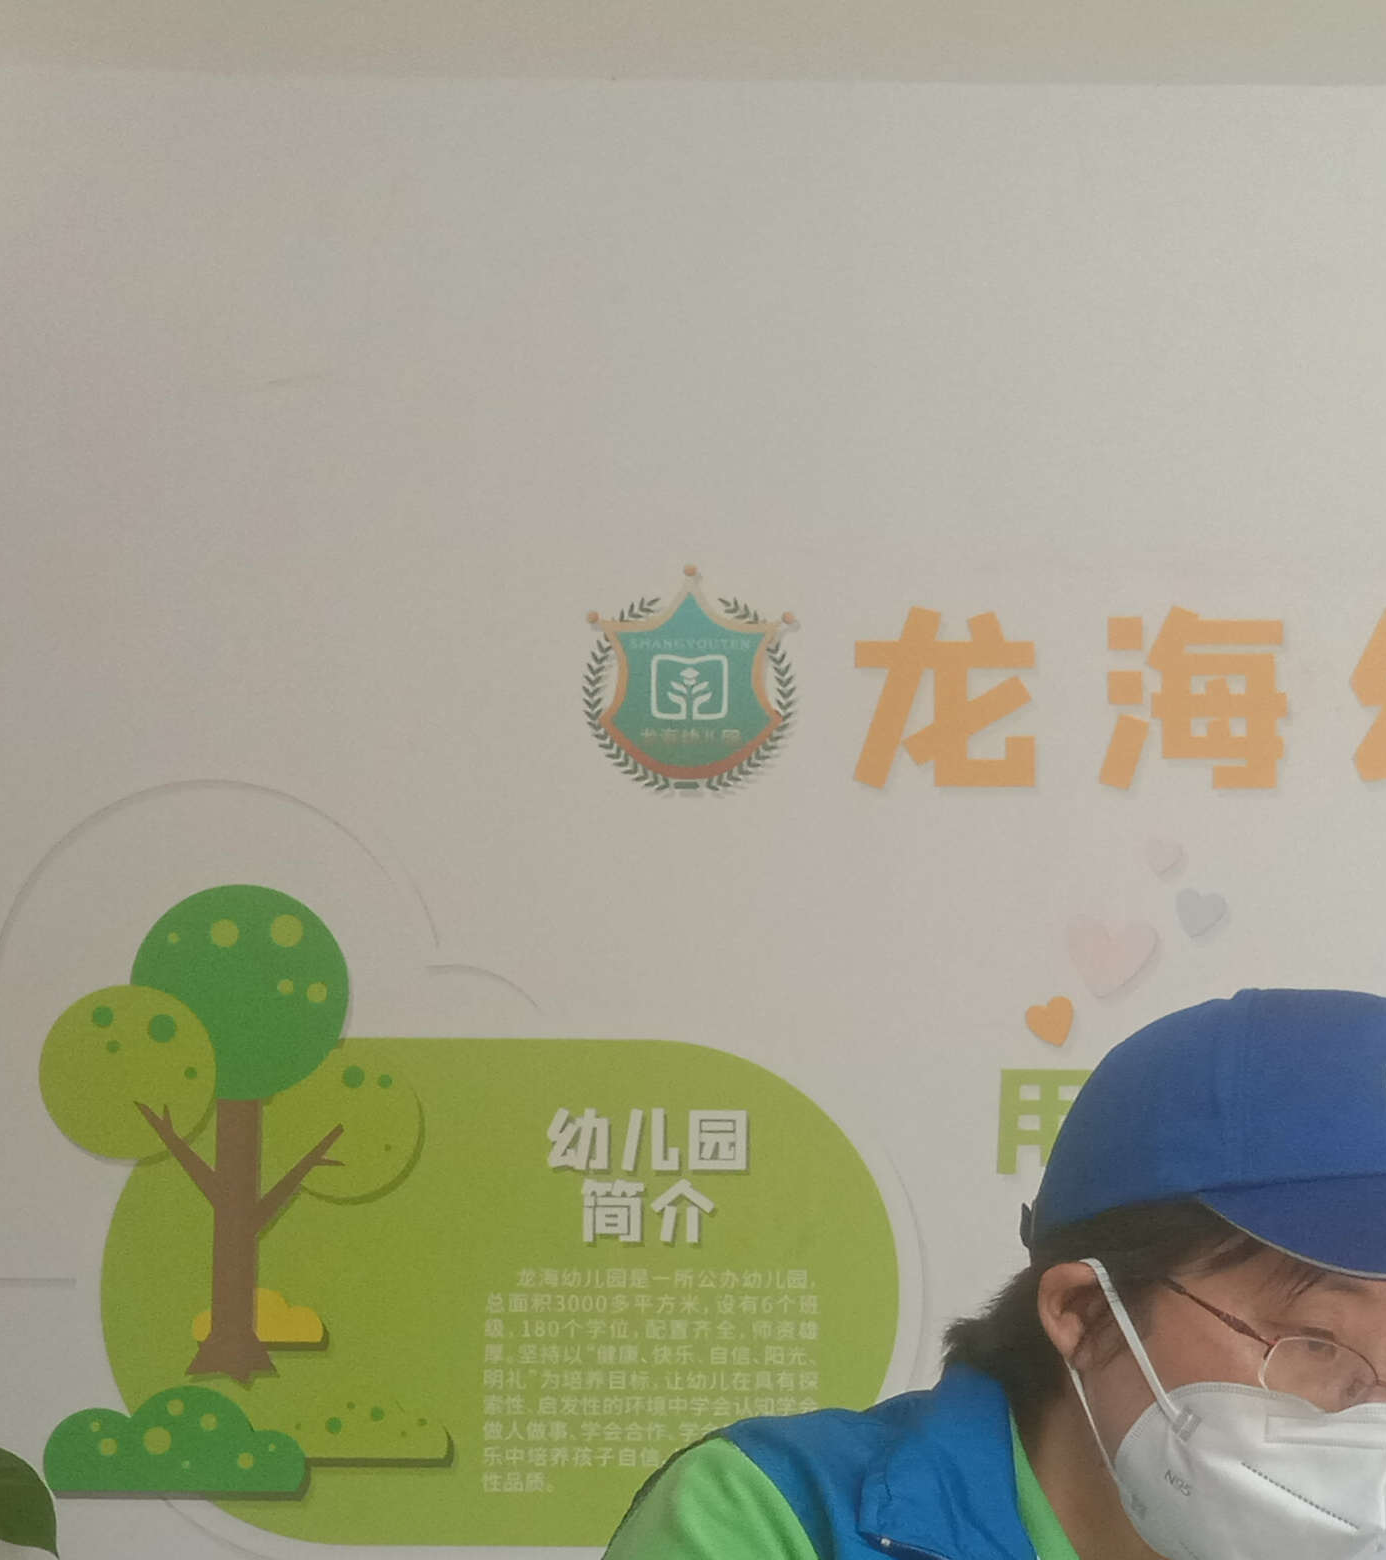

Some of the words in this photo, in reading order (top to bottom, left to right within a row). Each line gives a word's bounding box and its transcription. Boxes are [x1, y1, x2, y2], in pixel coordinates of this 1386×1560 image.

[547, 1107, 749, 1172] 幼儿园
[582, 1178, 716, 1243] 简介
